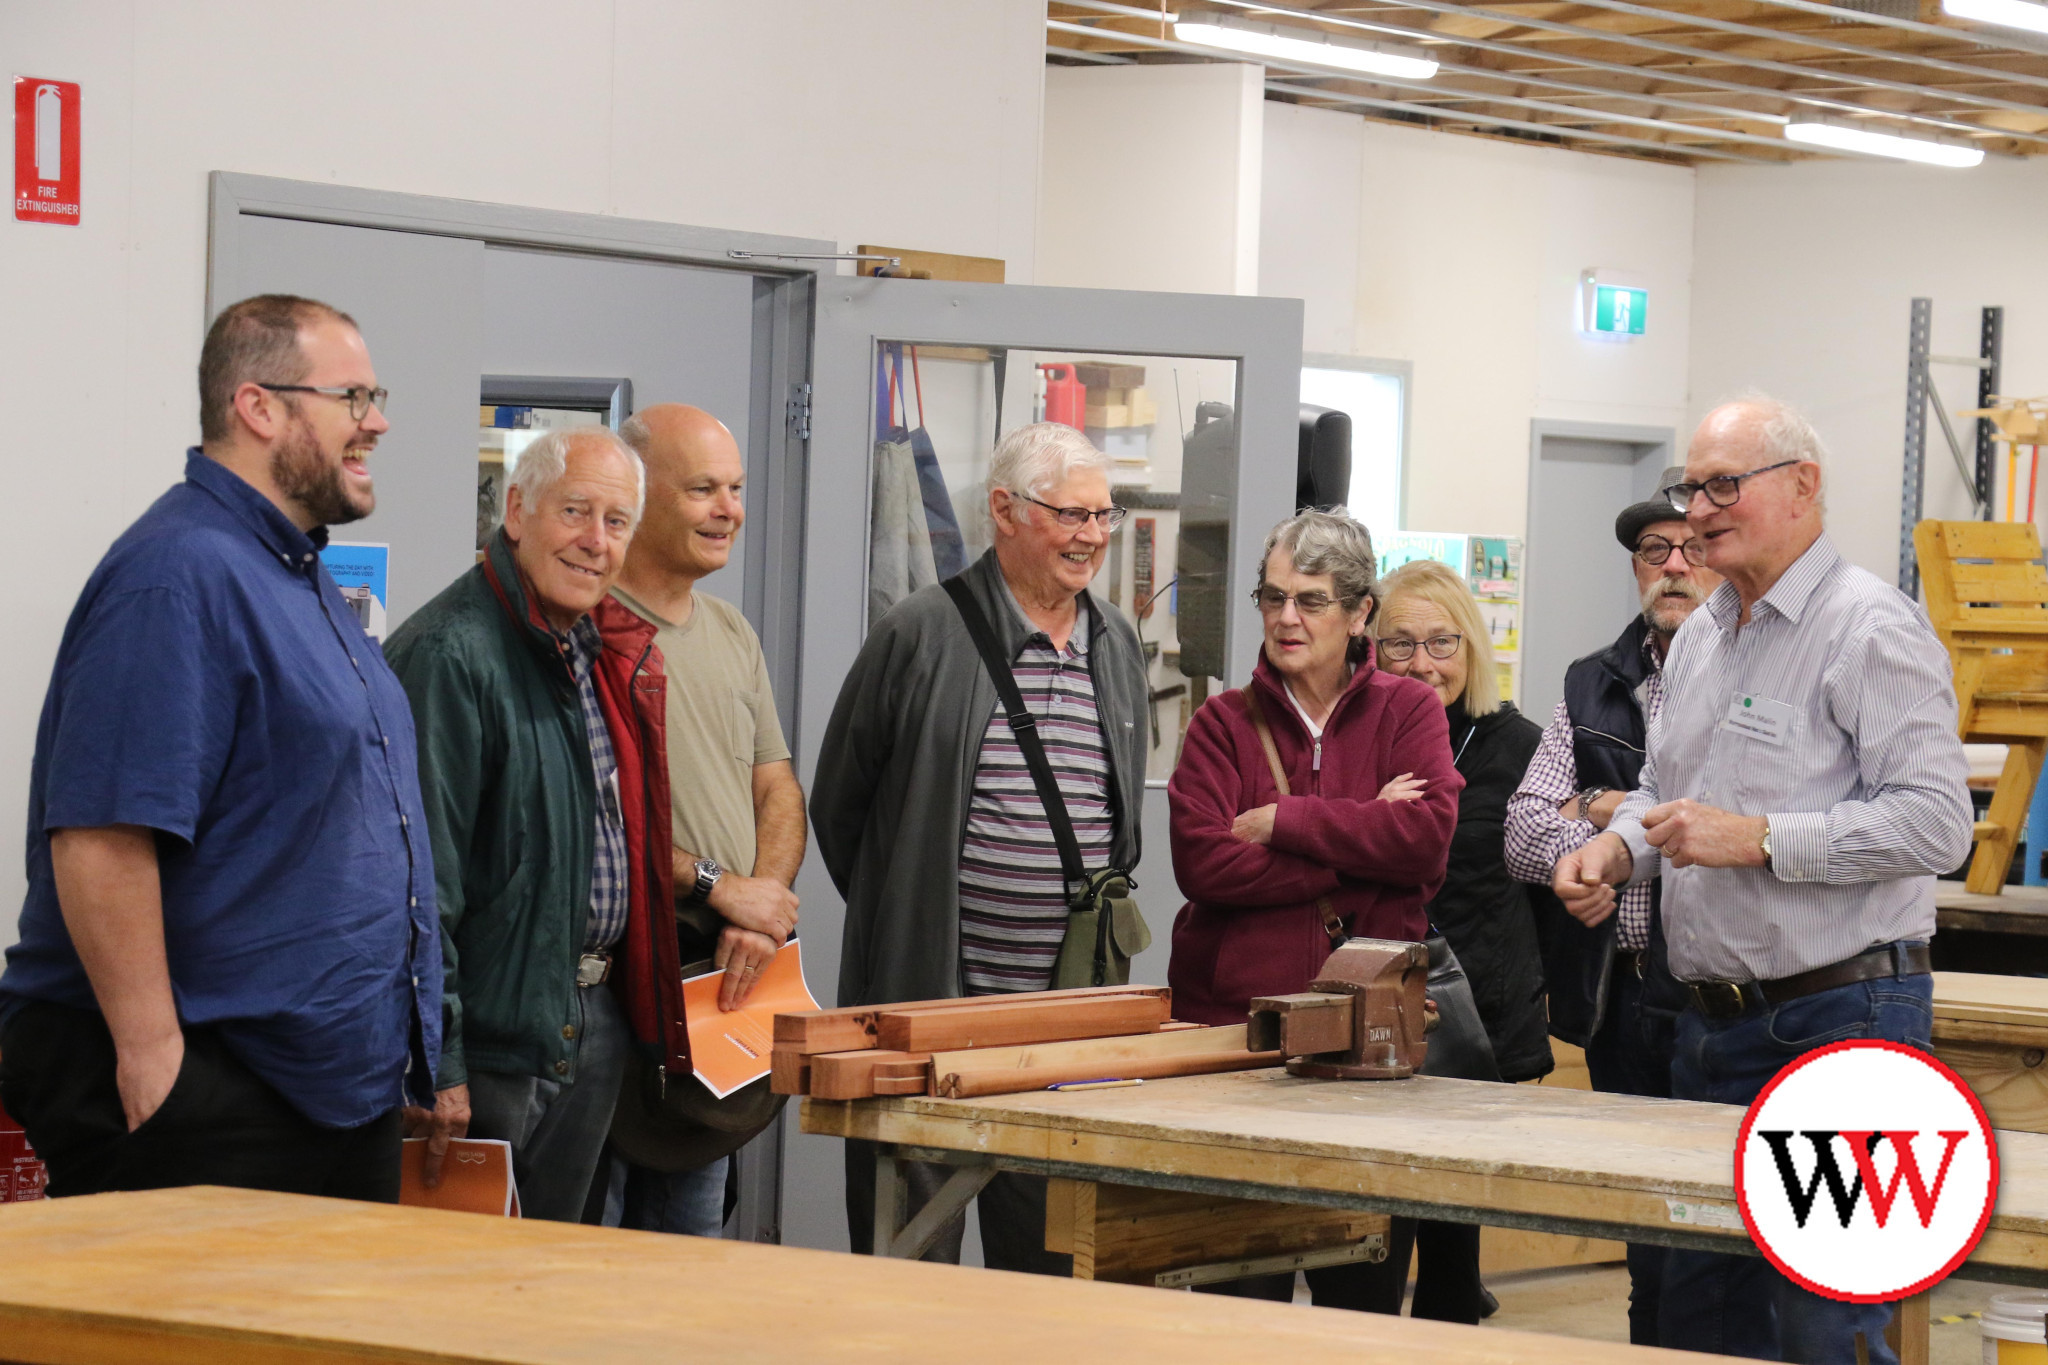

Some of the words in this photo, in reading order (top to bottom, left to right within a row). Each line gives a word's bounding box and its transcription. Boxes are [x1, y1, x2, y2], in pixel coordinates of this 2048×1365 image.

[38, 186, 58, 198] FIRE
[16, 199, 79, 215] EXTINGUISHER
[1369, 1026, 1391, 1042] DAWN
